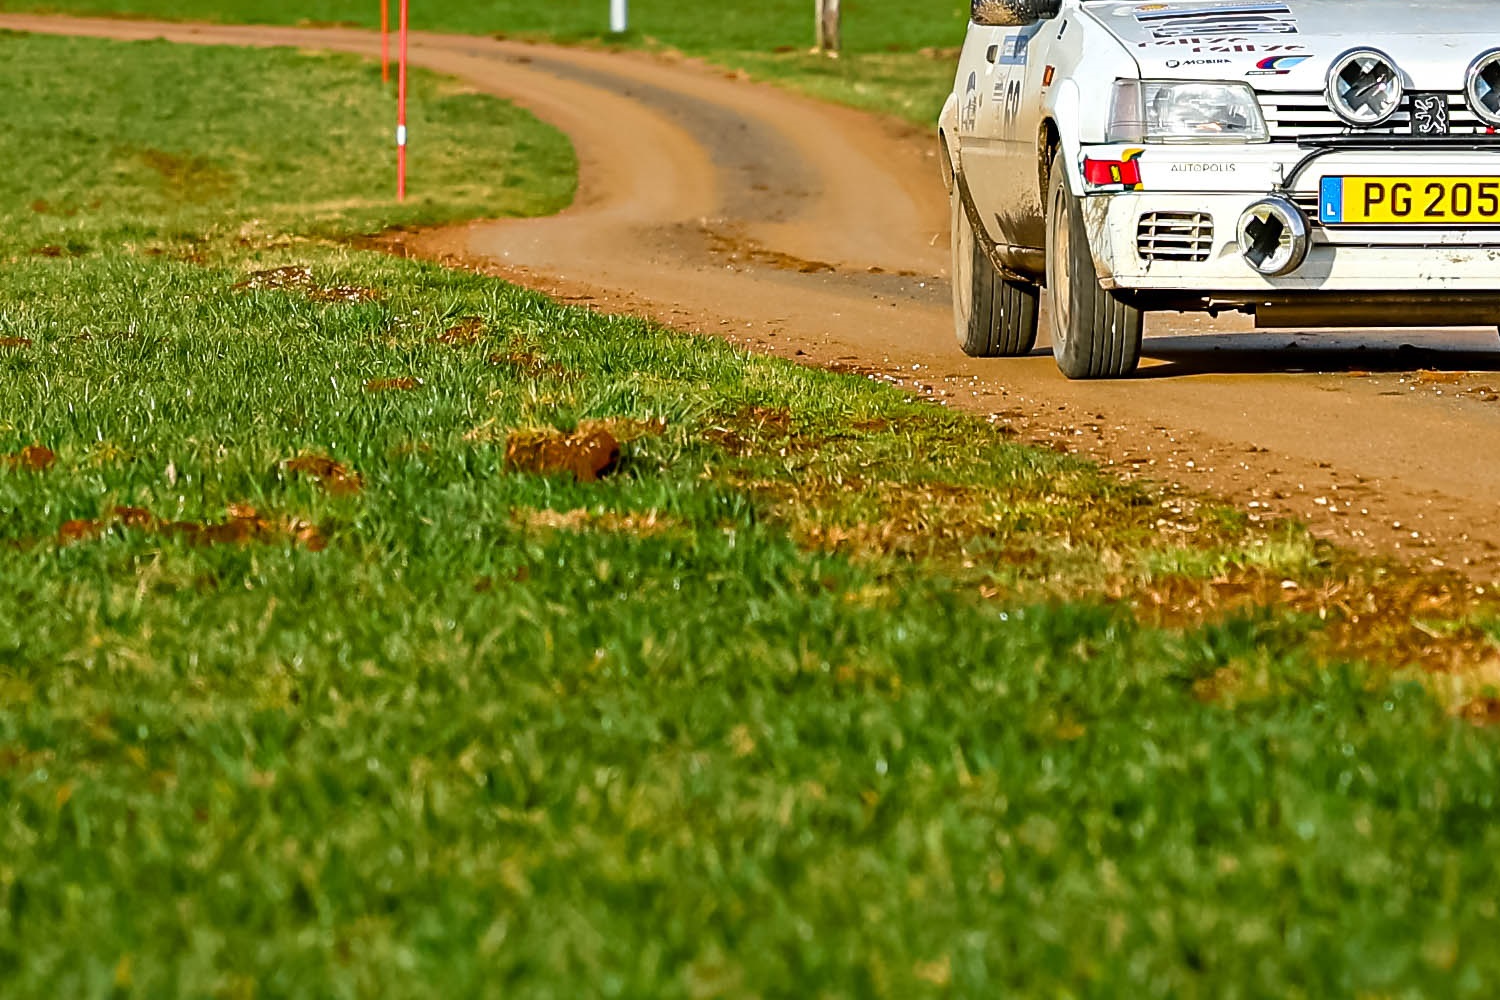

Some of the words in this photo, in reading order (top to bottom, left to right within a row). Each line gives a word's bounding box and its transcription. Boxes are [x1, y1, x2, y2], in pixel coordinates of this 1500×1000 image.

[1170, 163, 1236, 172] AUTOPOLIS
[1363, 182, 1412, 217] PG
[1326, 202, 1336, 216] L
